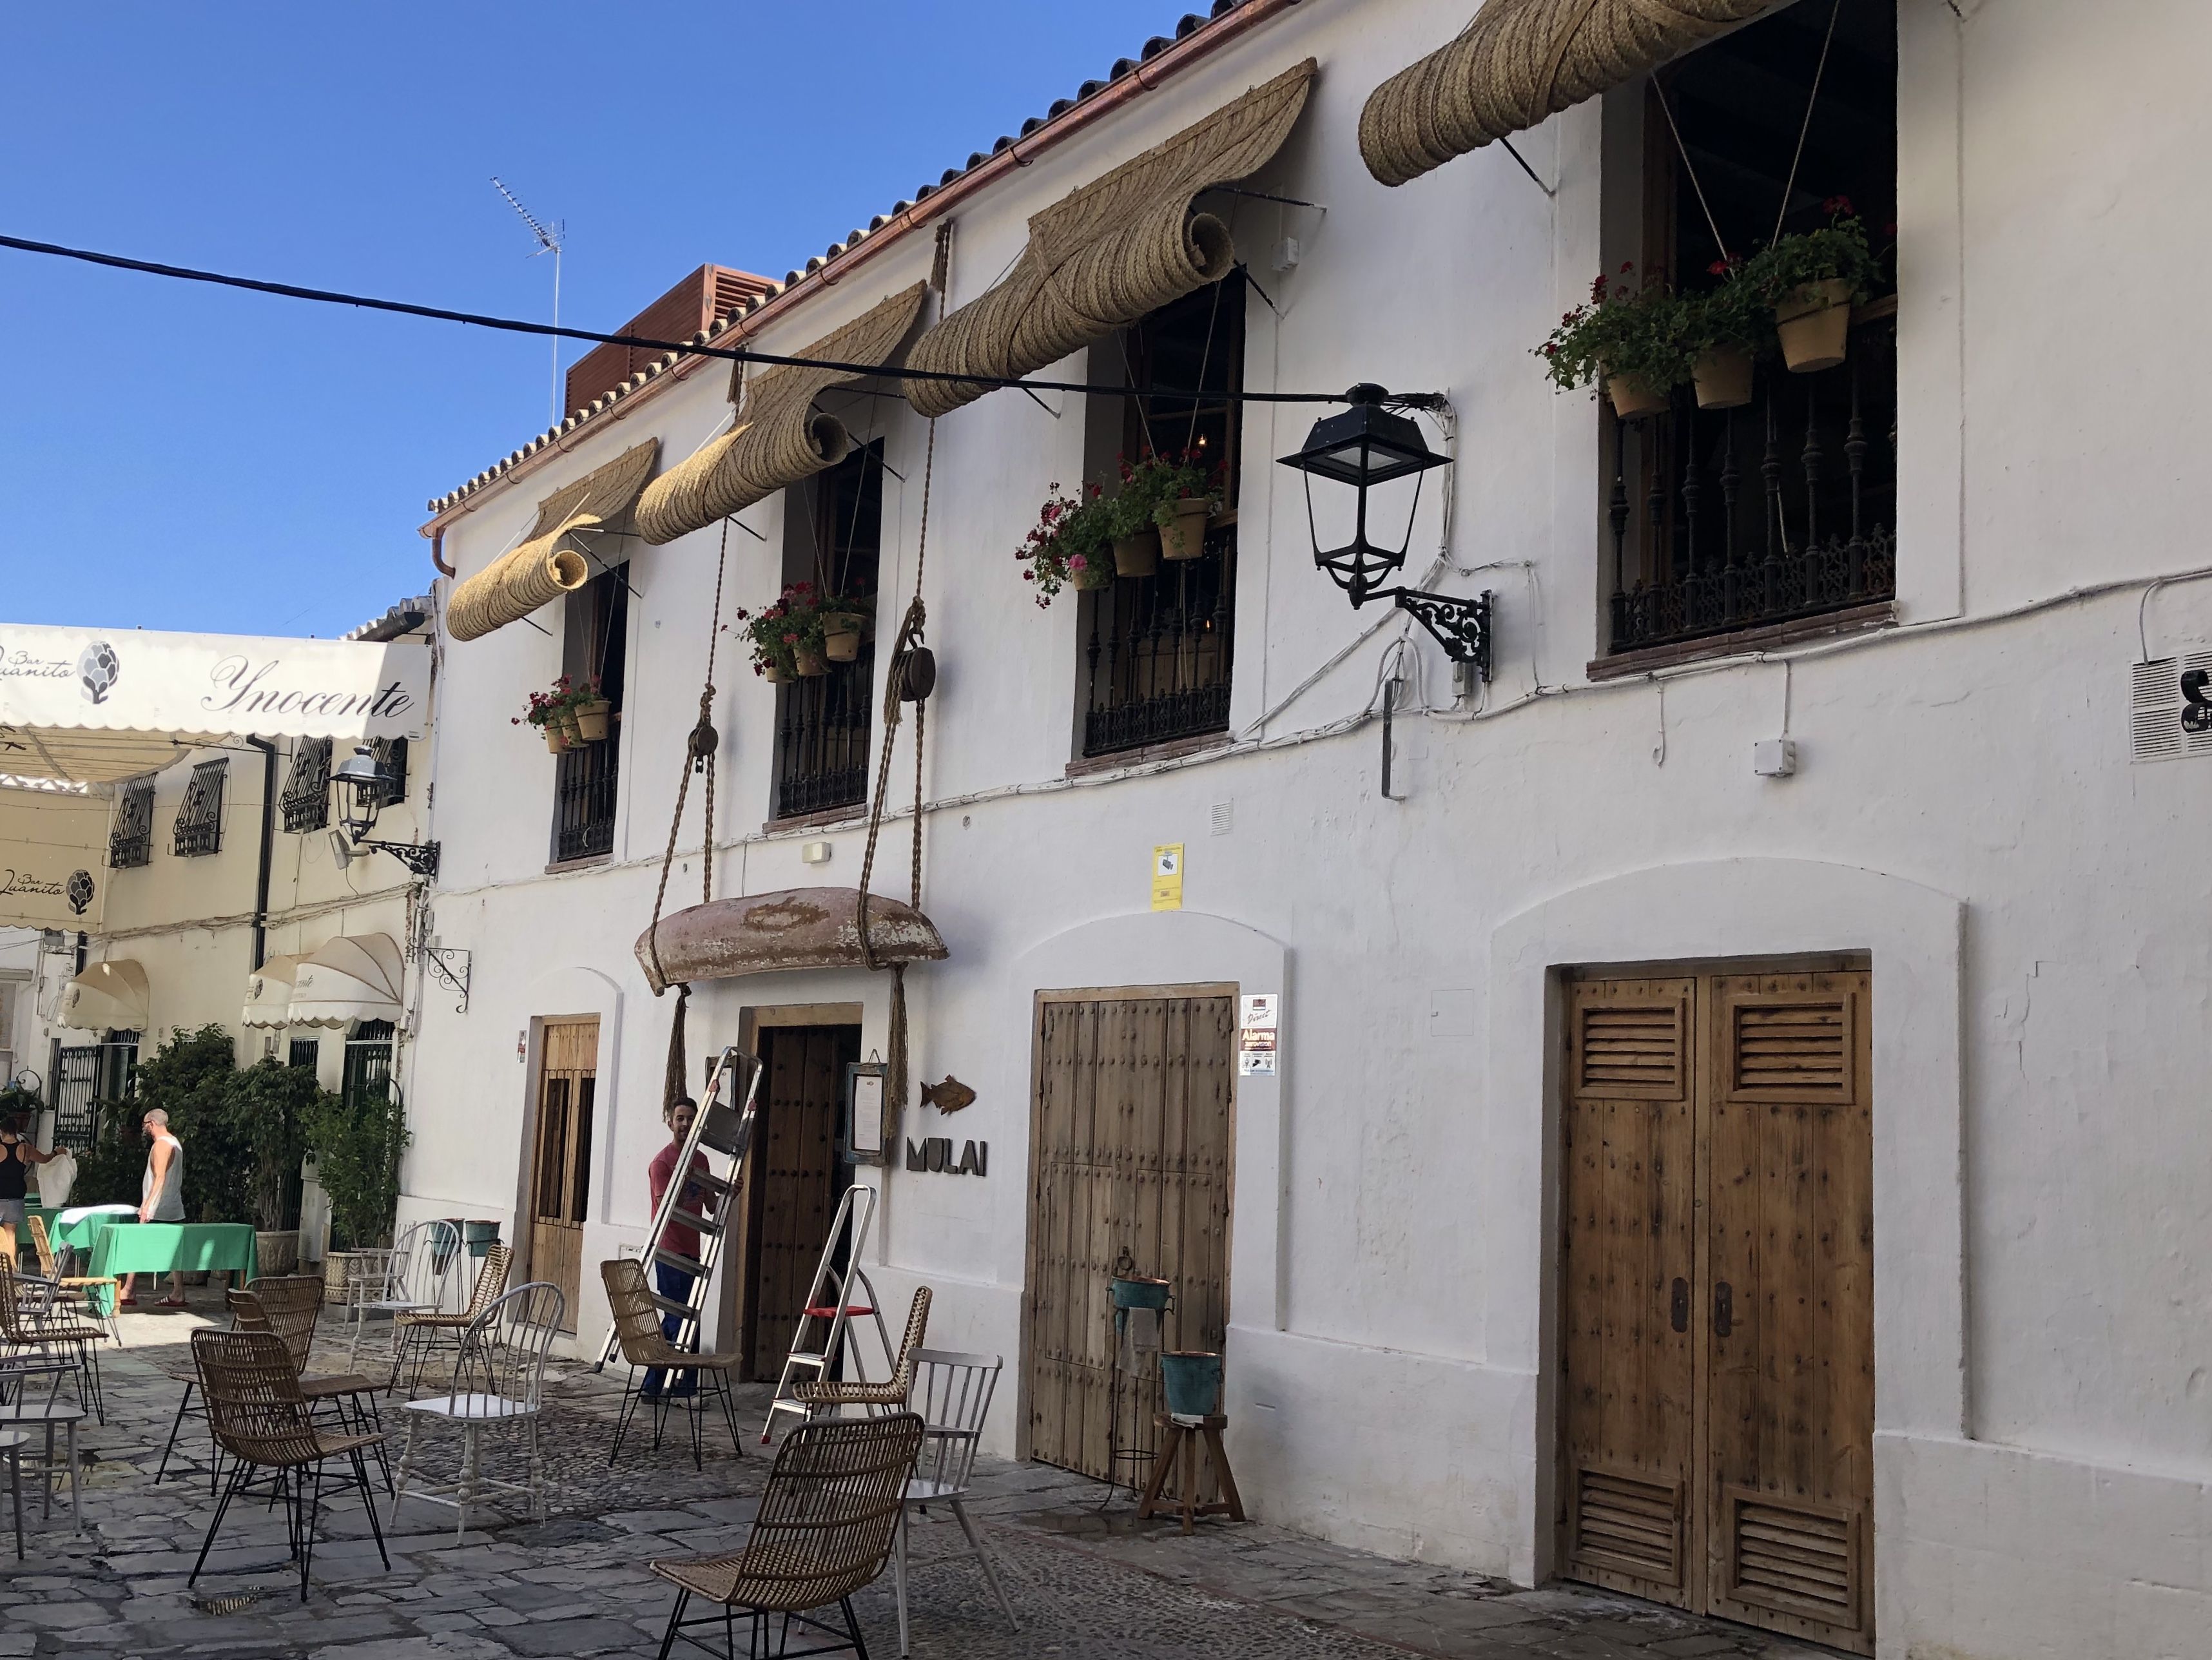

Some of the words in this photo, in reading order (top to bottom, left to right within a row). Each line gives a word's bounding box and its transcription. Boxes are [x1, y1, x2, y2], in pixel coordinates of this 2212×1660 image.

[8, 650, 44, 667] Bar
[200, 655, 414, 718] Ynocente
[17, 873, 43, 885] Bar
[1241, 1029, 1275, 1041] Alarma
[906, 1136, 985, 1177] MULAI
